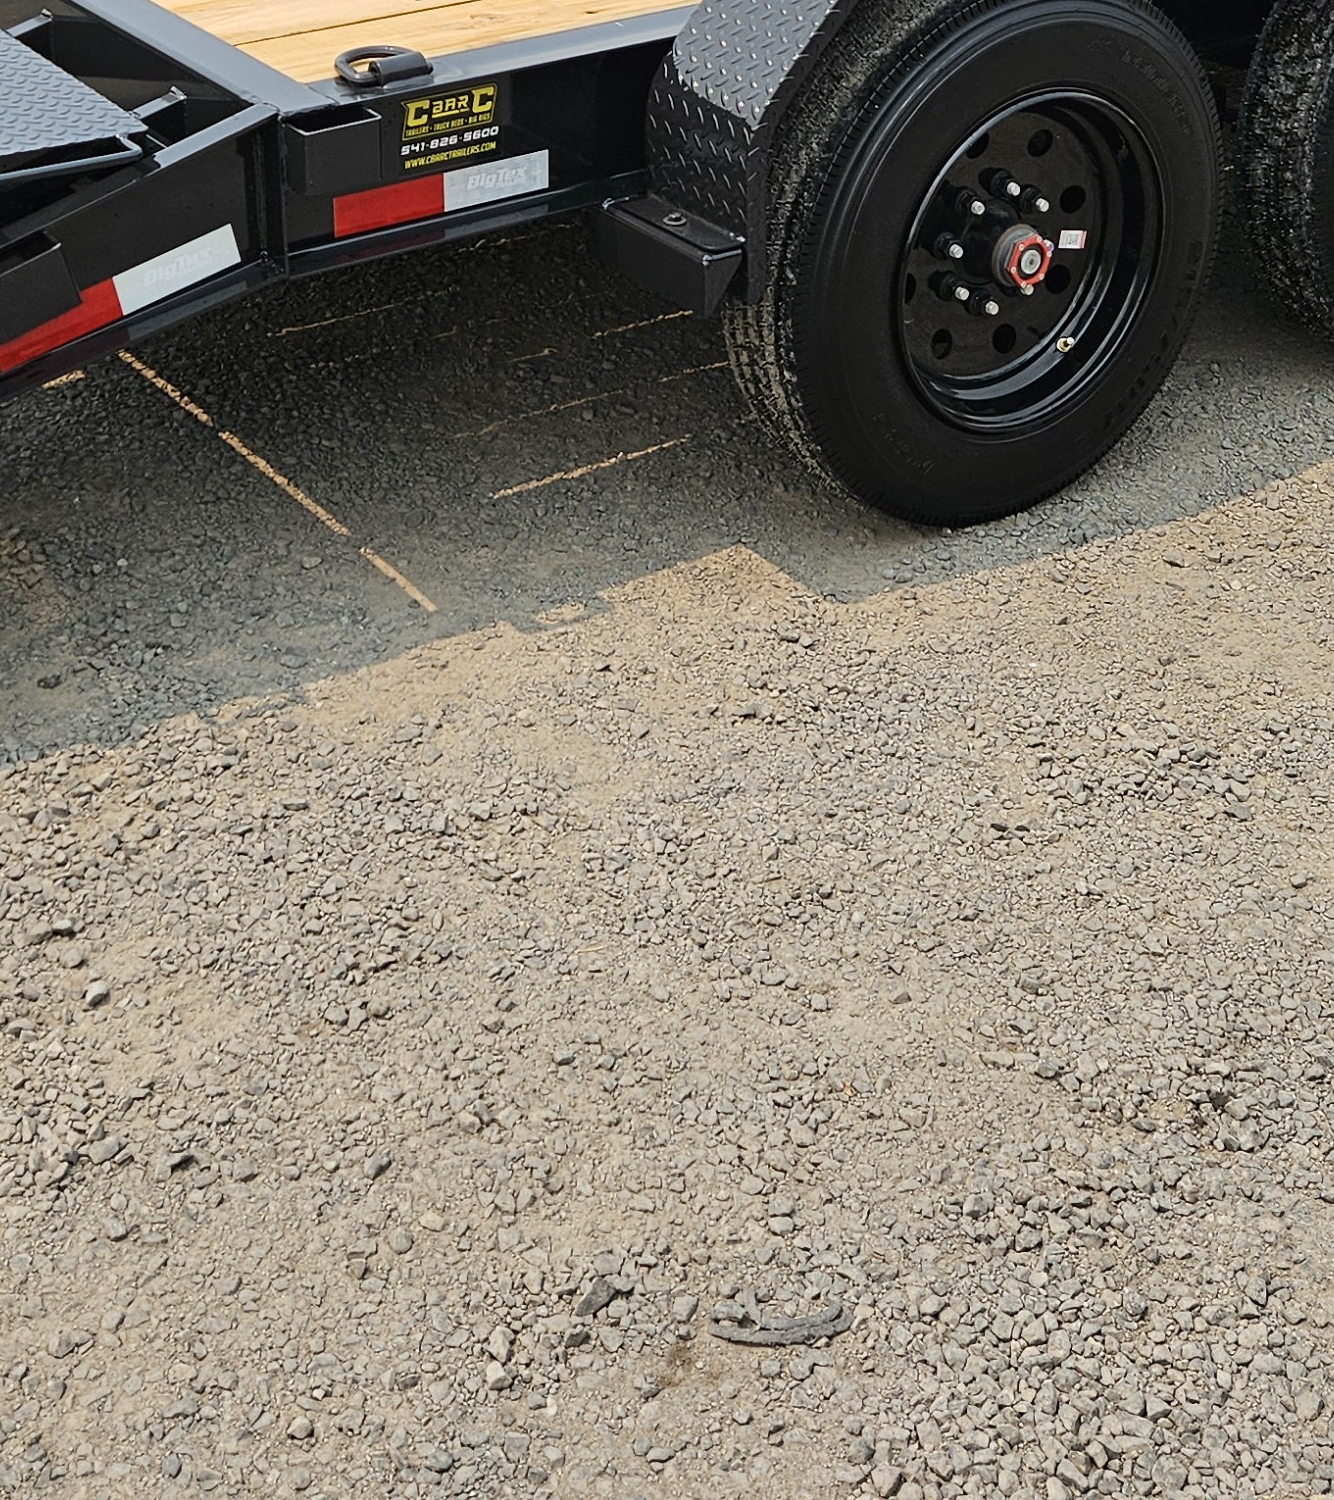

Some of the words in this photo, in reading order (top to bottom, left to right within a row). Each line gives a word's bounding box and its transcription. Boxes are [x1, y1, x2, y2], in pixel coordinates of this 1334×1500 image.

[406, 100, 430, 127] C
[472, 87, 494, 113] C
[434, 120, 450, 132] TRUCK
[466, 165, 529, 190] BigTex
